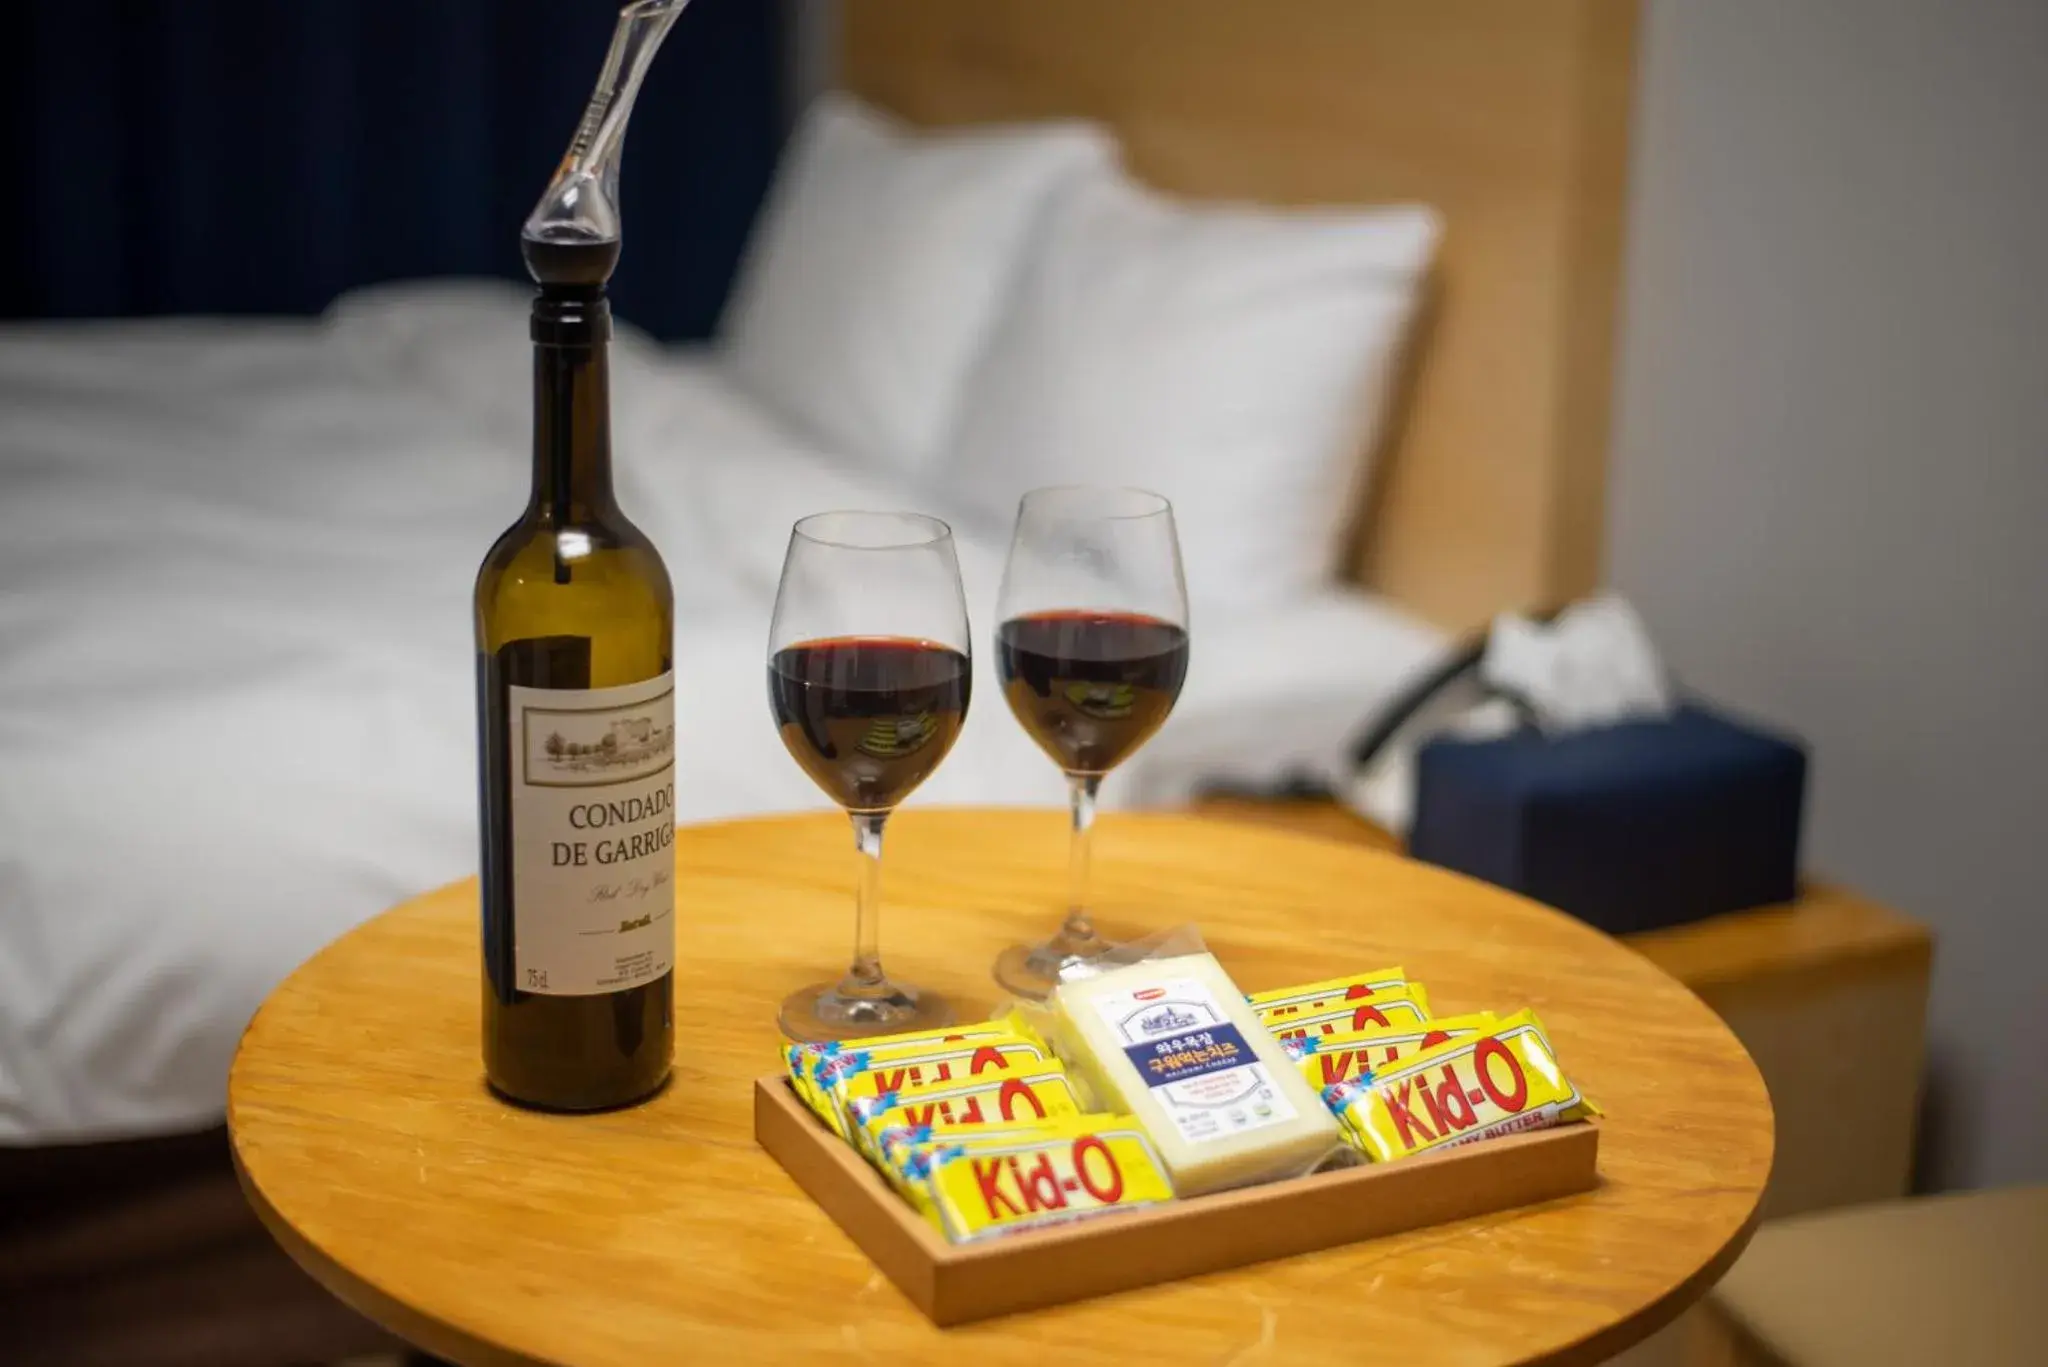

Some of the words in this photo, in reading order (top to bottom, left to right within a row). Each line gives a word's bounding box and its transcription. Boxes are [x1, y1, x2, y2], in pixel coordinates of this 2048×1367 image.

[552, 842, 588, 866] DE
[1381, 1037, 1528, 1149] Kid-O
[1484, 1110, 1544, 1140] BUTTER
[970, 1134, 1124, 1220] Kid-O
